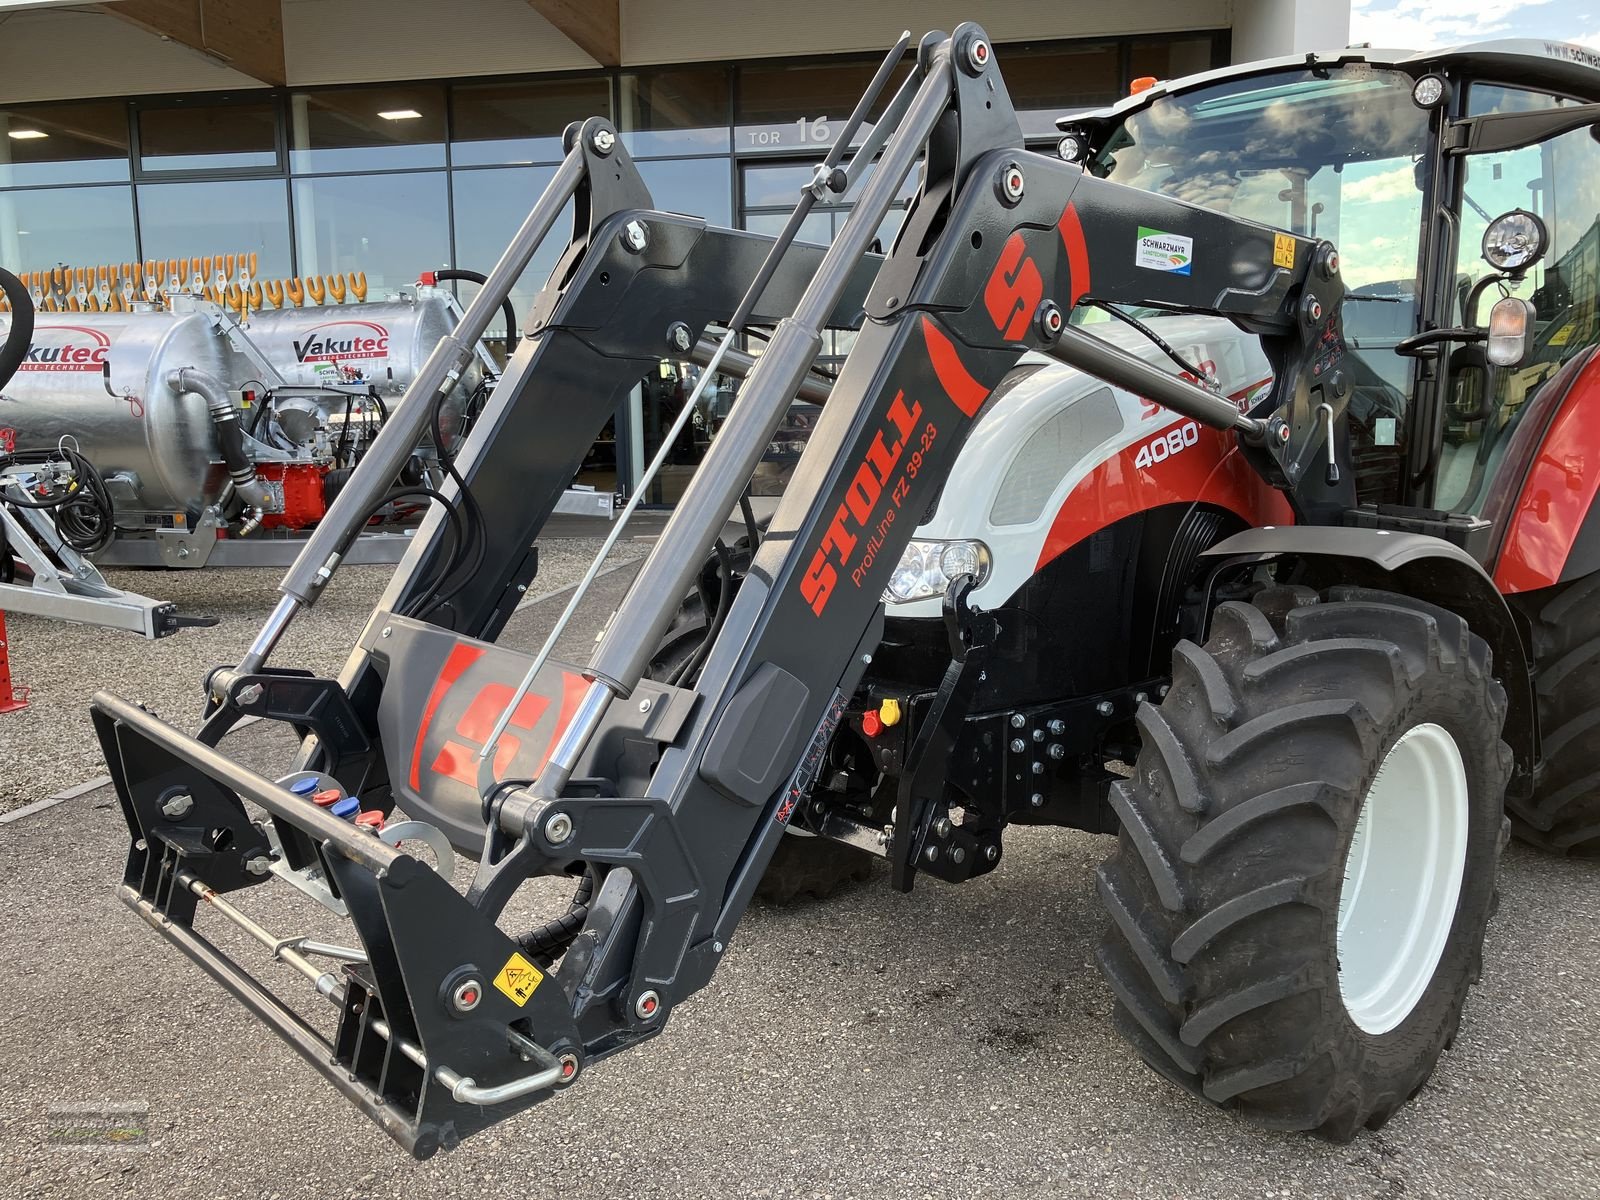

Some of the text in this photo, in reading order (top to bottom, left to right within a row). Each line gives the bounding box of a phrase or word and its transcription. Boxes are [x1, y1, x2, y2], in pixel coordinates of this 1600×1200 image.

[748, 115, 831, 145] TOR 16
[1142, 238, 1186, 254] SCHWARZMAYR
[293, 334, 389, 363] Vakutec
[1134, 421, 1199, 470] 4080
[800, 389, 923, 618] STOLL
[851, 422, 938, 588] ProfiLine FZ 39-23
